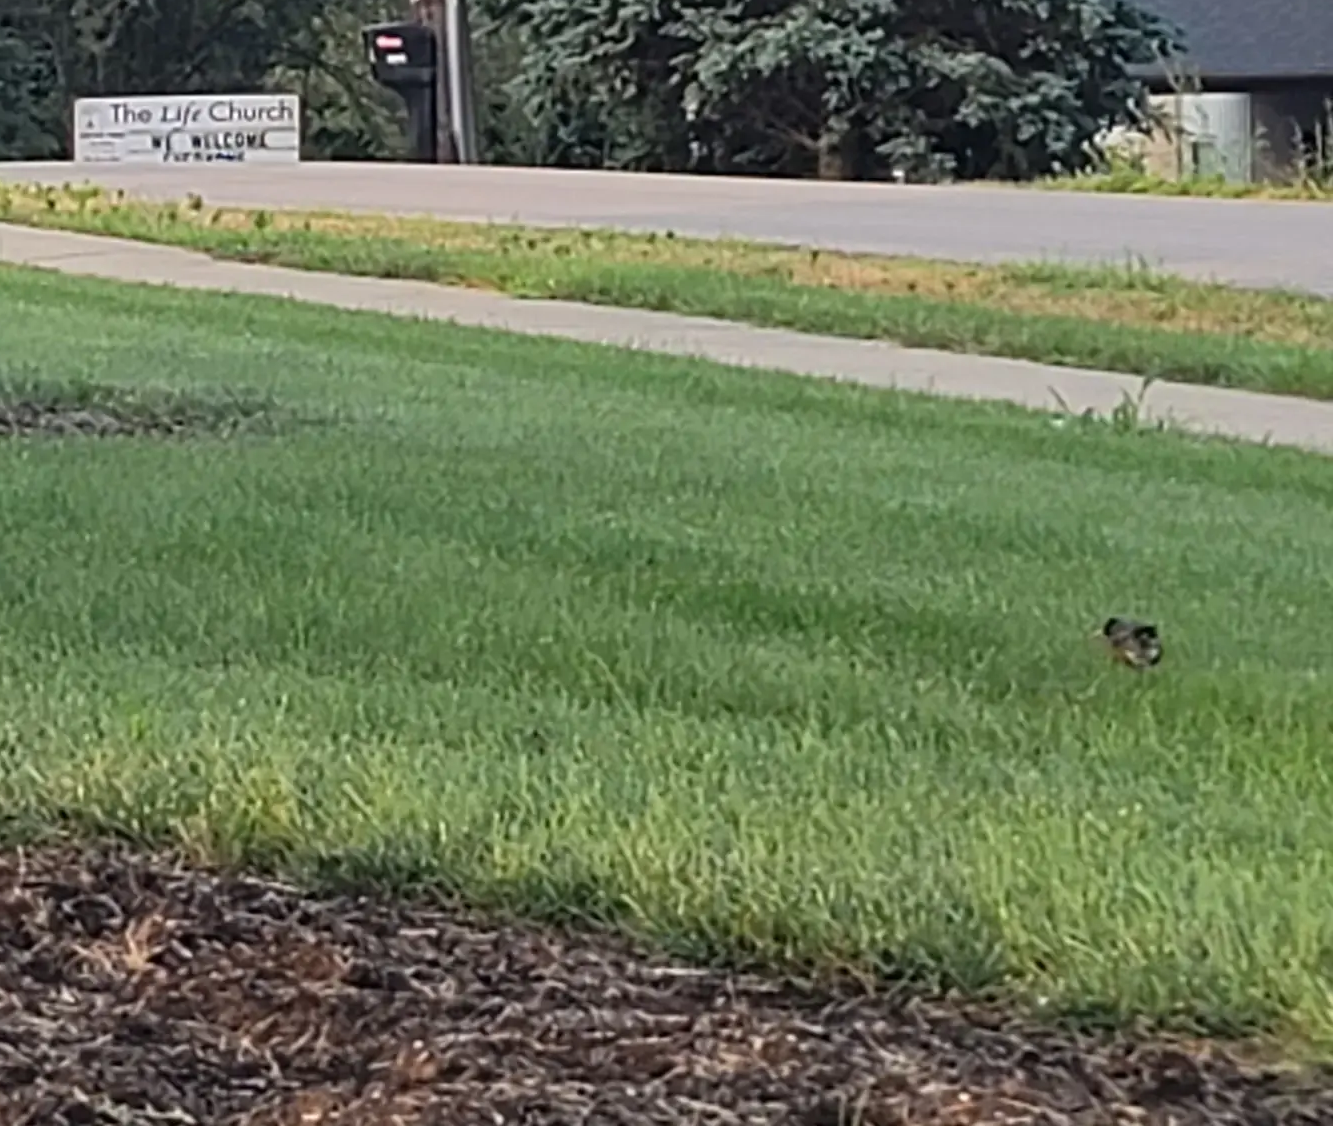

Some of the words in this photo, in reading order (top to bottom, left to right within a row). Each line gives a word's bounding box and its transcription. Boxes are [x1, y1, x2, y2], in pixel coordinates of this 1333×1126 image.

[109, 101, 153, 124] The
[159, 100, 202, 126] Life
[208, 99, 295, 123] Church
